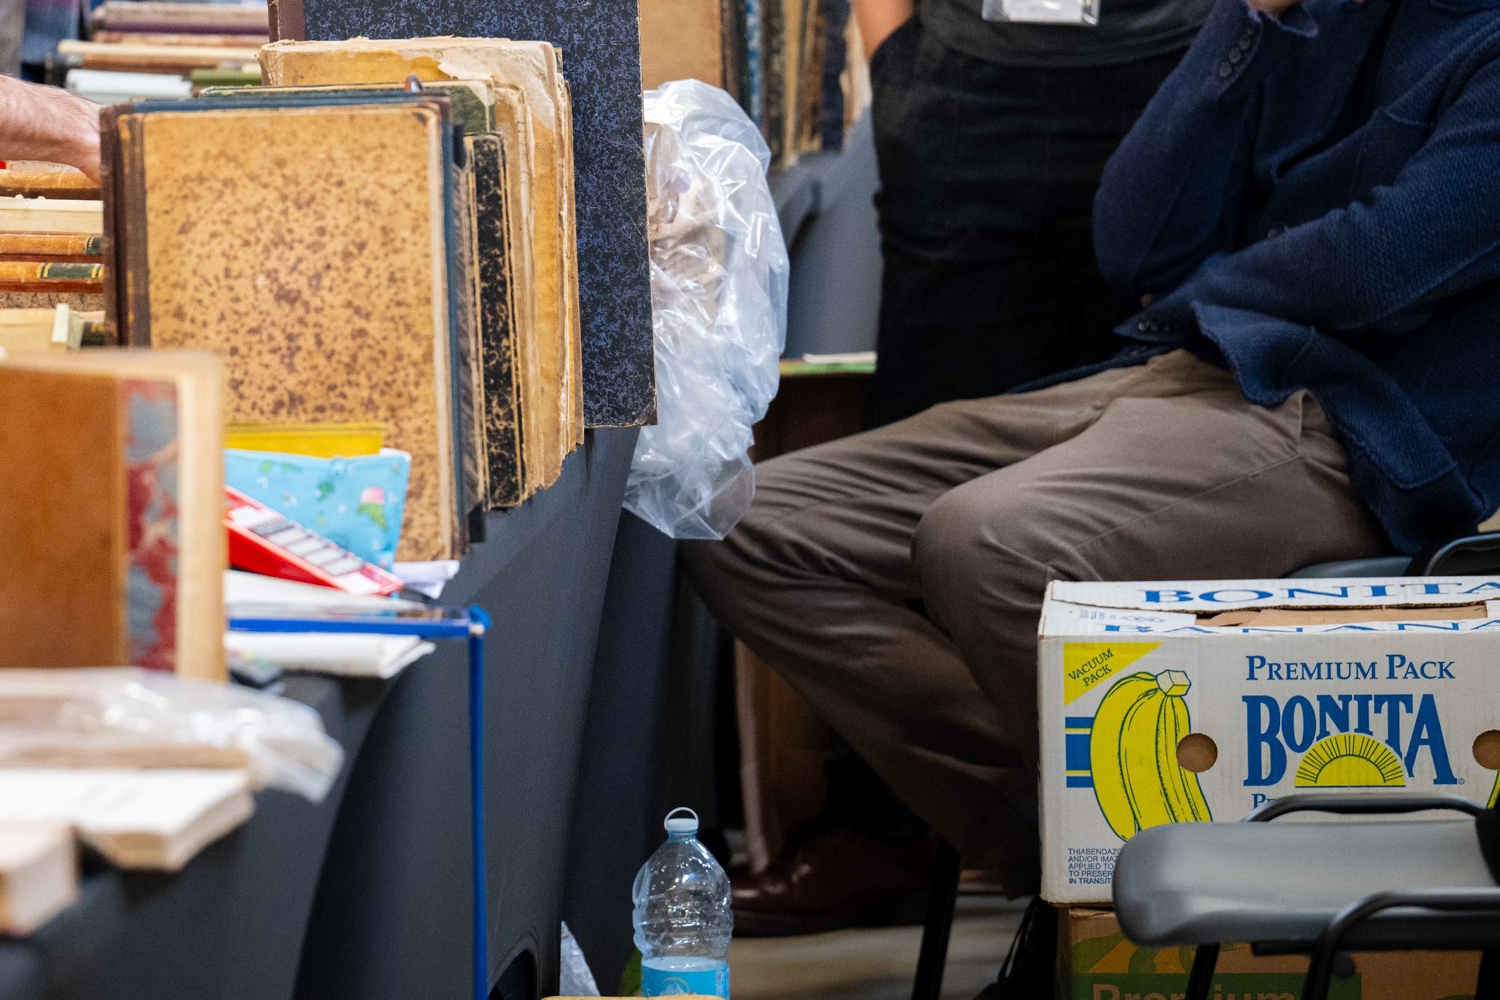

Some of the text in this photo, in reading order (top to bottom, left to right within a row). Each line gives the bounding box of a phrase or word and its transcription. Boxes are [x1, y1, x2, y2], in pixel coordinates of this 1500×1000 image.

[1068, 648, 1114, 681] VACUUM
[1082, 663, 1113, 687] PACK
[1245, 654, 1456, 681] PREMIUM PACK
[1241, 694, 1458, 787] BONITA
[1068, 855, 1099, 863] AND/OR
[1068, 877, 1112, 885] IN TRANSIT
